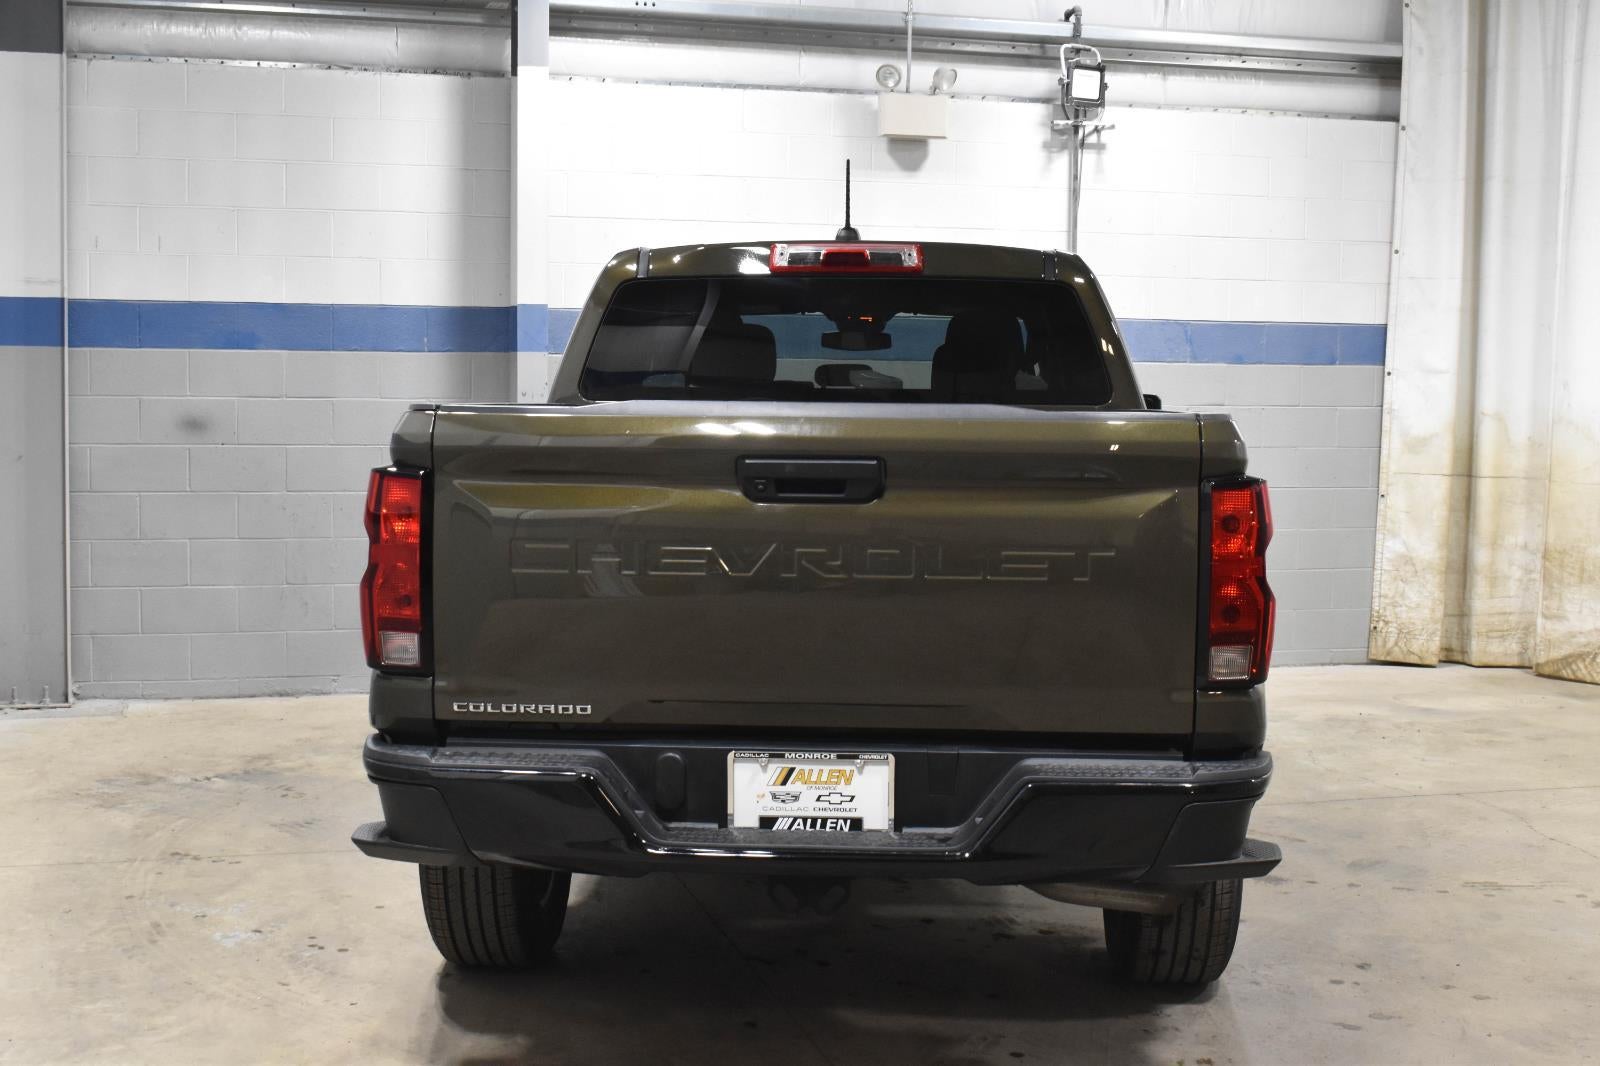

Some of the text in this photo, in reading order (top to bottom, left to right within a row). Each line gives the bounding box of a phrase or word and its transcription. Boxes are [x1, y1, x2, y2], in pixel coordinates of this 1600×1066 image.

[509, 535, 1117, 582] CHEVROLET
[452, 702, 592, 715] COLORADO
[791, 769, 854, 785] ALLEN
[791, 818, 851, 832] ALLEN
